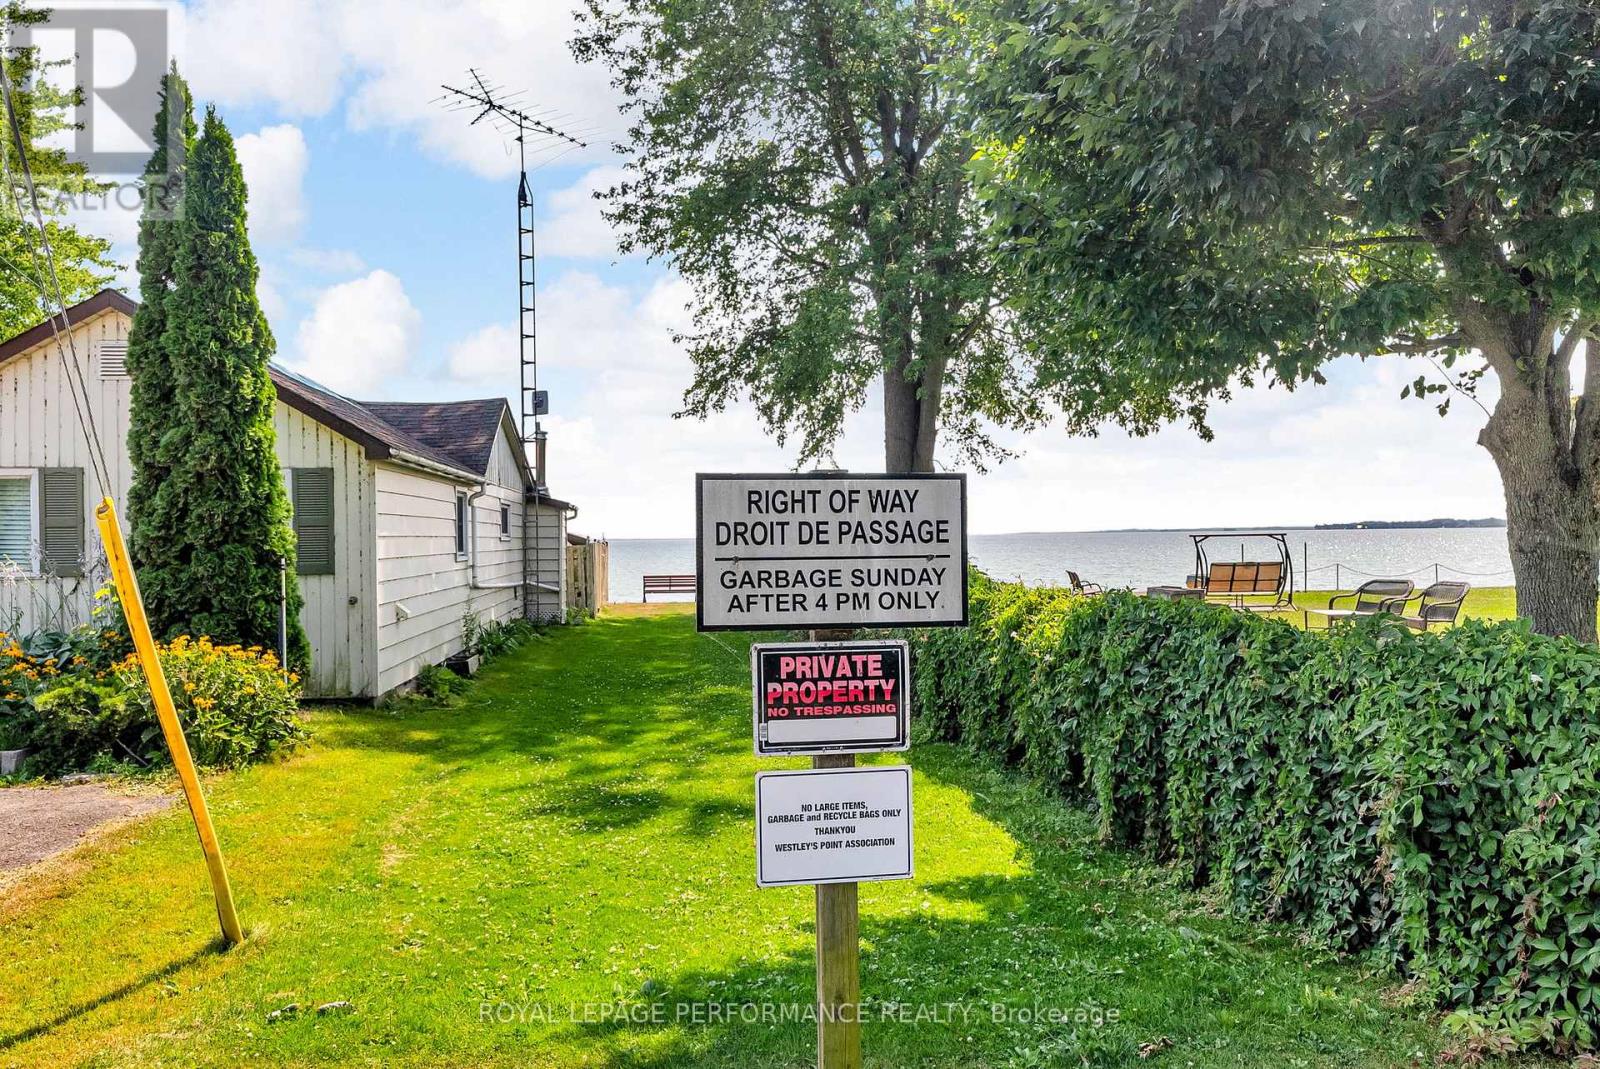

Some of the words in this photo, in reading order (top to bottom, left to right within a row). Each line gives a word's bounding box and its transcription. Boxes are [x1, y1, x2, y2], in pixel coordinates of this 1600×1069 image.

[747, 490, 821, 514] RIGHT
[829, 490, 861, 513] OF
[868, 489, 919, 513] WAY
[715, 521, 790, 546] DROIT
[799, 521, 830, 545] DE
[838, 519, 949, 545] PASSAGE
[720, 569, 842, 589] GARBAGE
[850, 567, 946, 587] SUNDAY
[727, 593, 808, 613] AFTER
[815, 593, 828, 611] 4
[836, 592, 870, 611] PM
[780, 654, 883, 679] PRIVATE
[767, 679, 896, 705] PROPERTY
[767, 707, 789, 717] NO
[794, 704, 897, 716] TRESPASSING
[767, 814, 804, 823] GARBAGE
[806, 813, 821, 821] and
[823, 811, 857, 821] RECYCLE
[859, 810, 880, 819] BAGS
[882, 808, 902, 817] ONLY
[801, 804, 812, 812] NO
[815, 803, 840, 811] LARGE
[842, 801, 868, 811] ITEMS,
[775, 842, 818, 852] WESTLEY'S
[820, 840, 843, 850] POINT
[845, 837, 895, 848] ASSOCIATION
